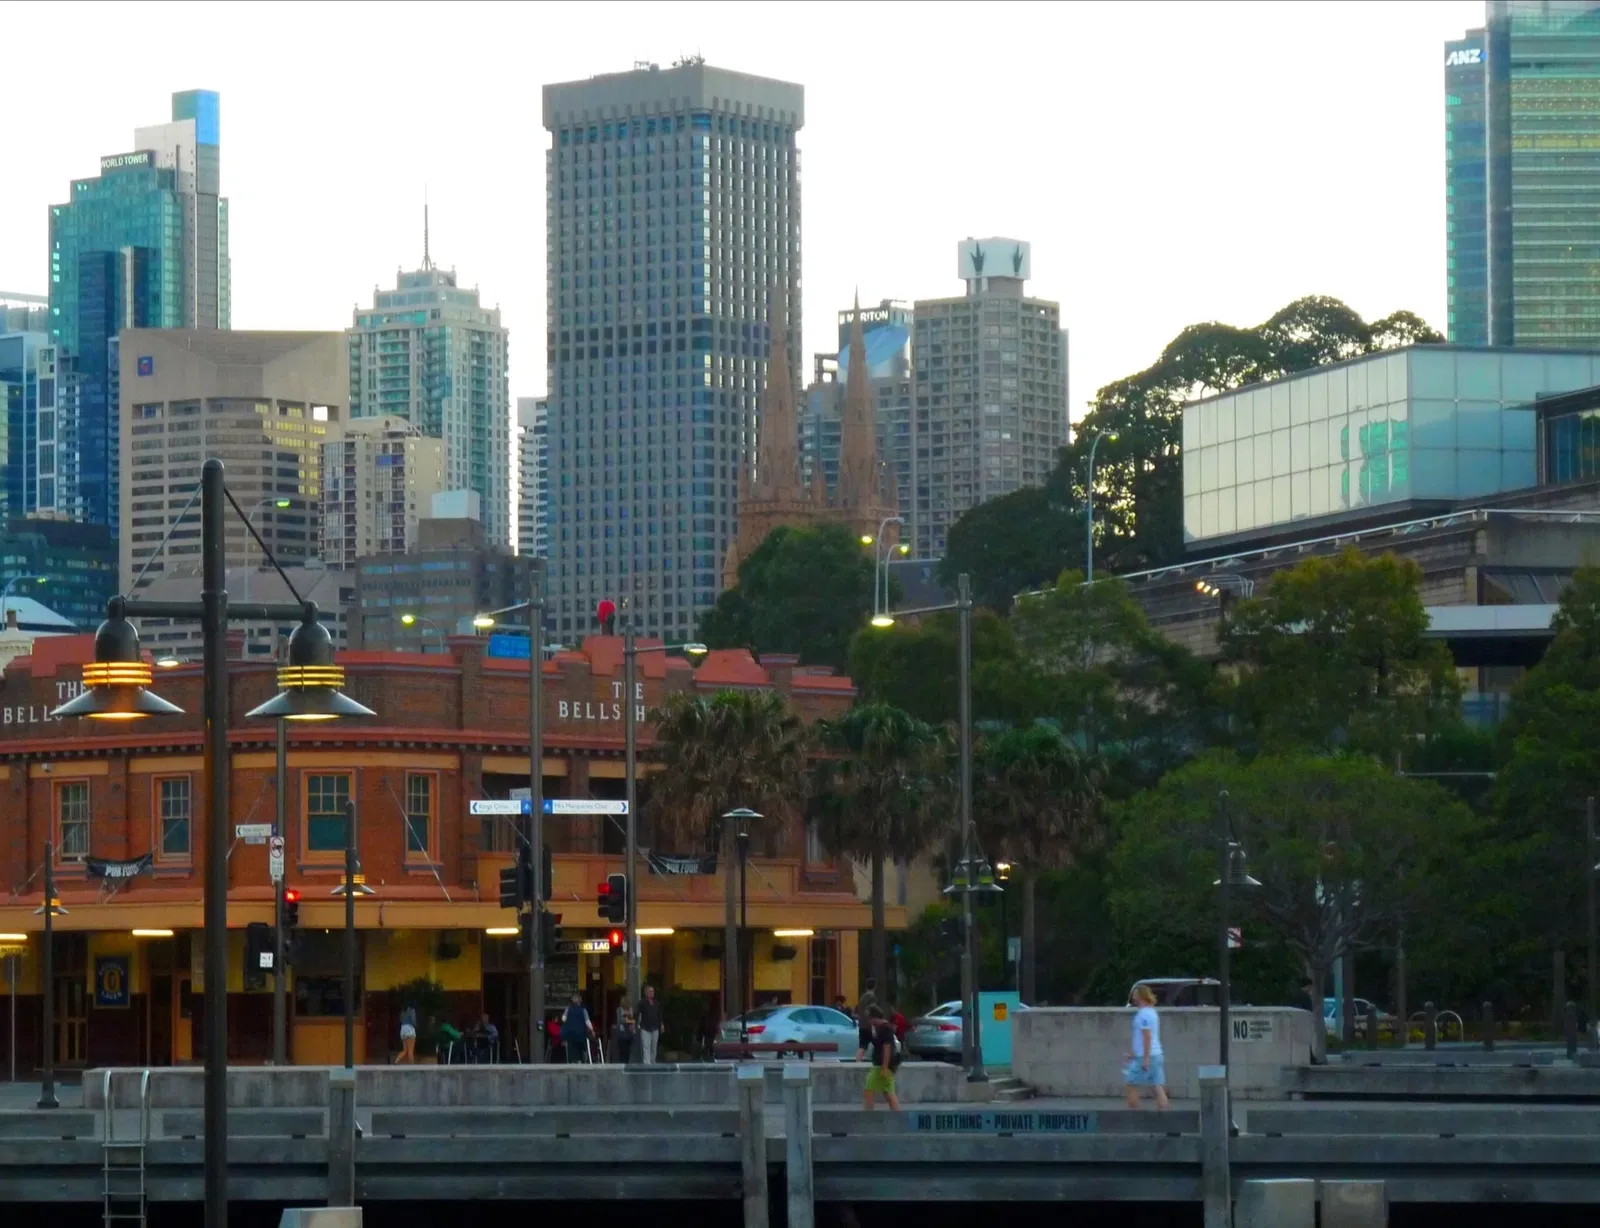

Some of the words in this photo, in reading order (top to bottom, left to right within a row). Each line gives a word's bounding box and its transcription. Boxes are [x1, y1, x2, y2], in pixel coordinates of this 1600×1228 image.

[1446, 49, 1481, 66] ANZ
[101, 157, 123, 168] WORLD
[124, 153, 148, 165] TOWER
[846, 309, 888, 323] MRITON
[612, 681, 644, 699] TE
[559, 700, 621, 720] BELLS
[1233, 1020, 1248, 1039] NO
[918, 1114, 931, 1130] NO
[935, 1114, 982, 1130] BERTHING
[995, 1114, 1034, 1130] PRIVATE
[1039, 1113, 1089, 1130] PROPERTY
